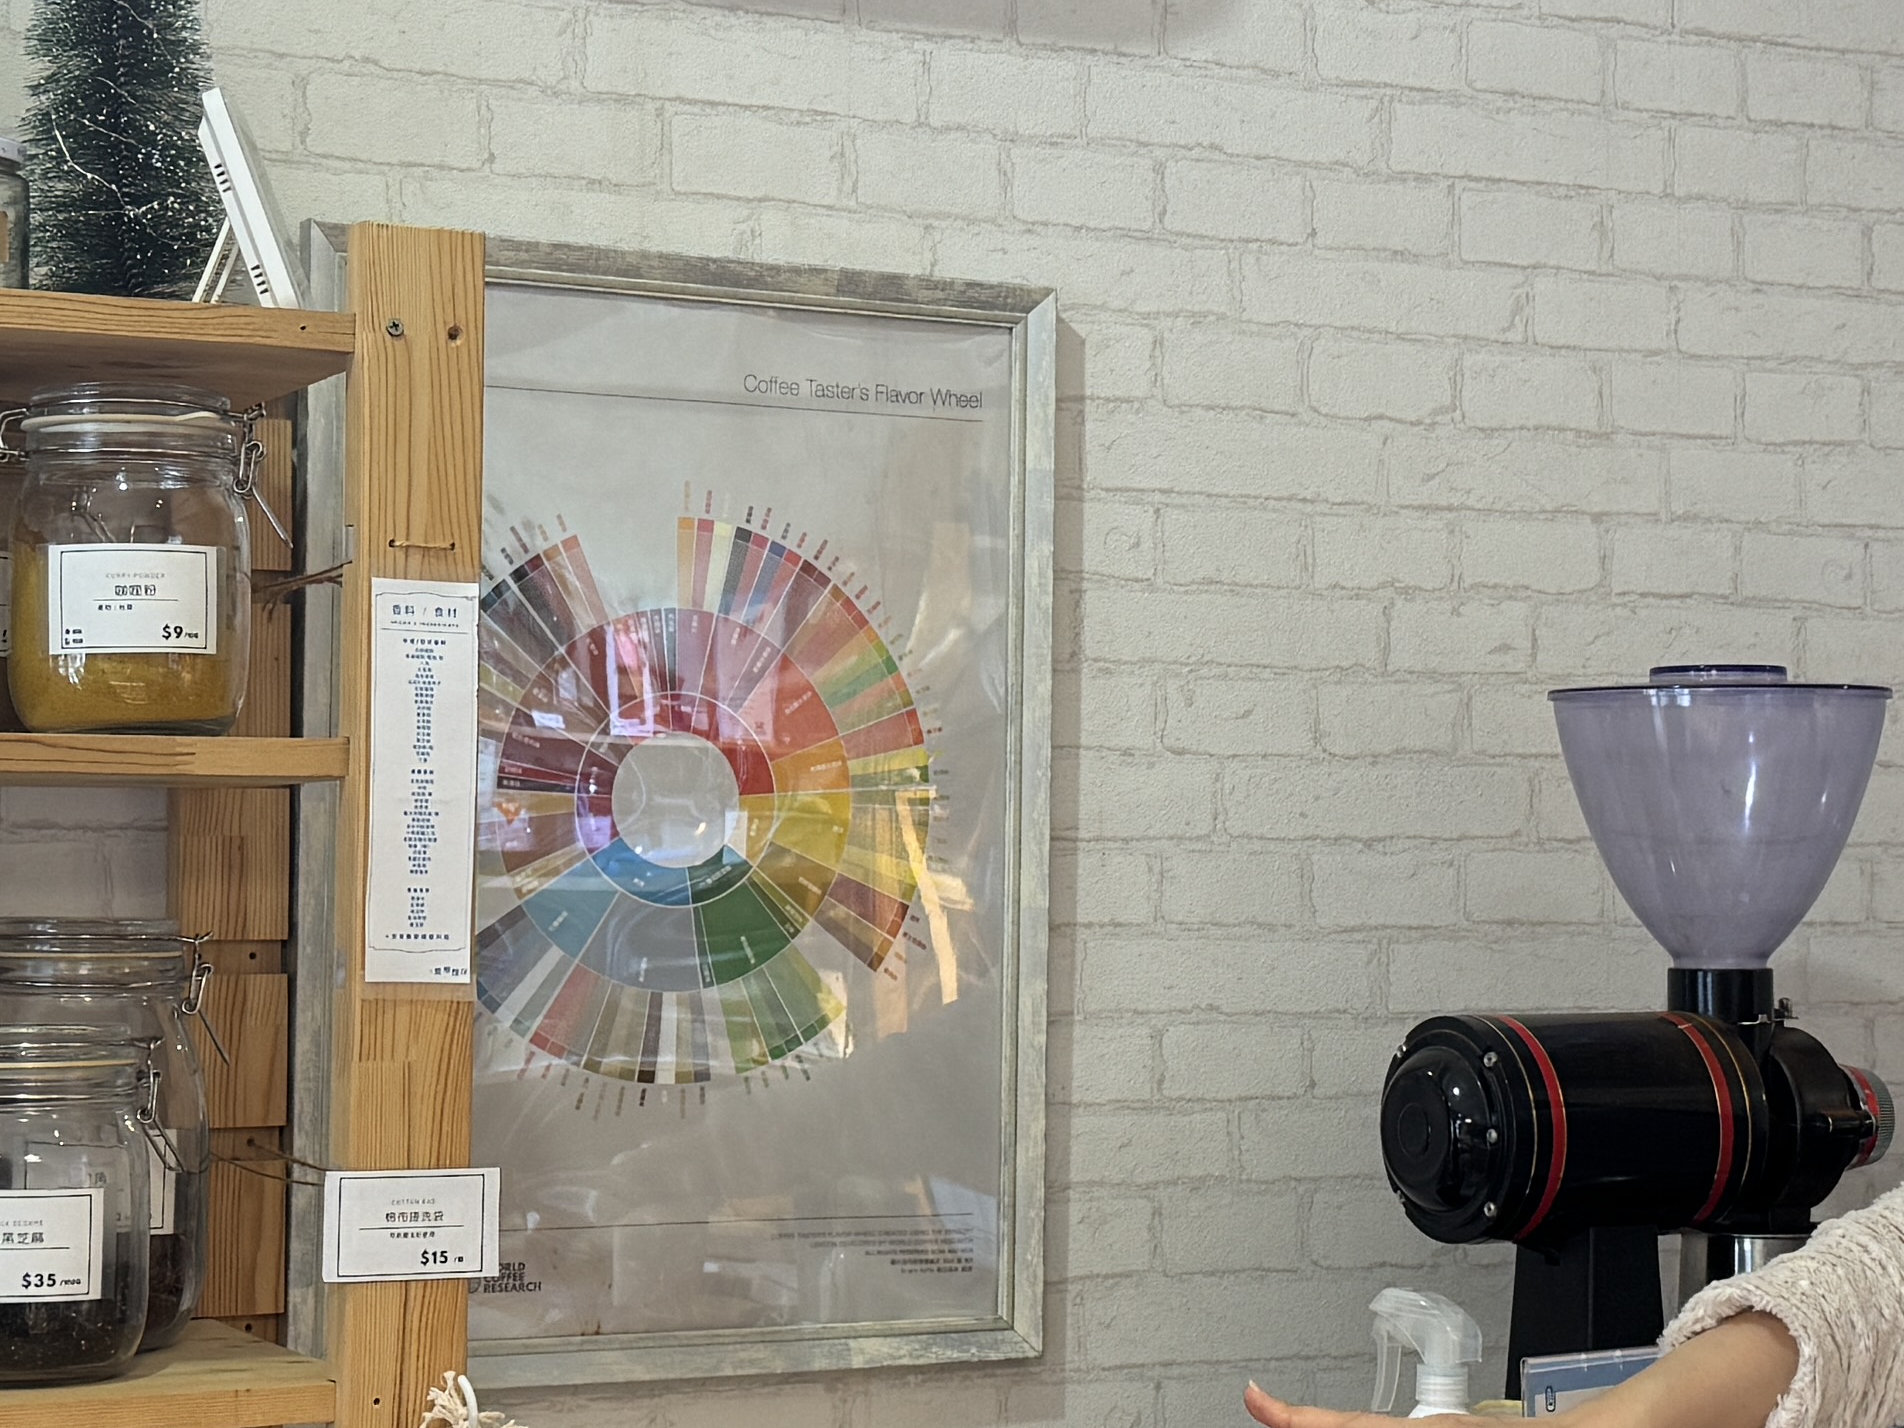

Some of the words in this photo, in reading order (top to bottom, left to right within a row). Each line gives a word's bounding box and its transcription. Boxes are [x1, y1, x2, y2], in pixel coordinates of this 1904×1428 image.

[743, 374, 800, 396] Coffee
[805, 379, 869, 402] Taster's
[875, 384, 925, 406] Flavor
[930, 387, 983, 409] Wheel
[499, 1262, 526, 1272] ORLD
[483, 1281, 542, 1293] RESEARCH
